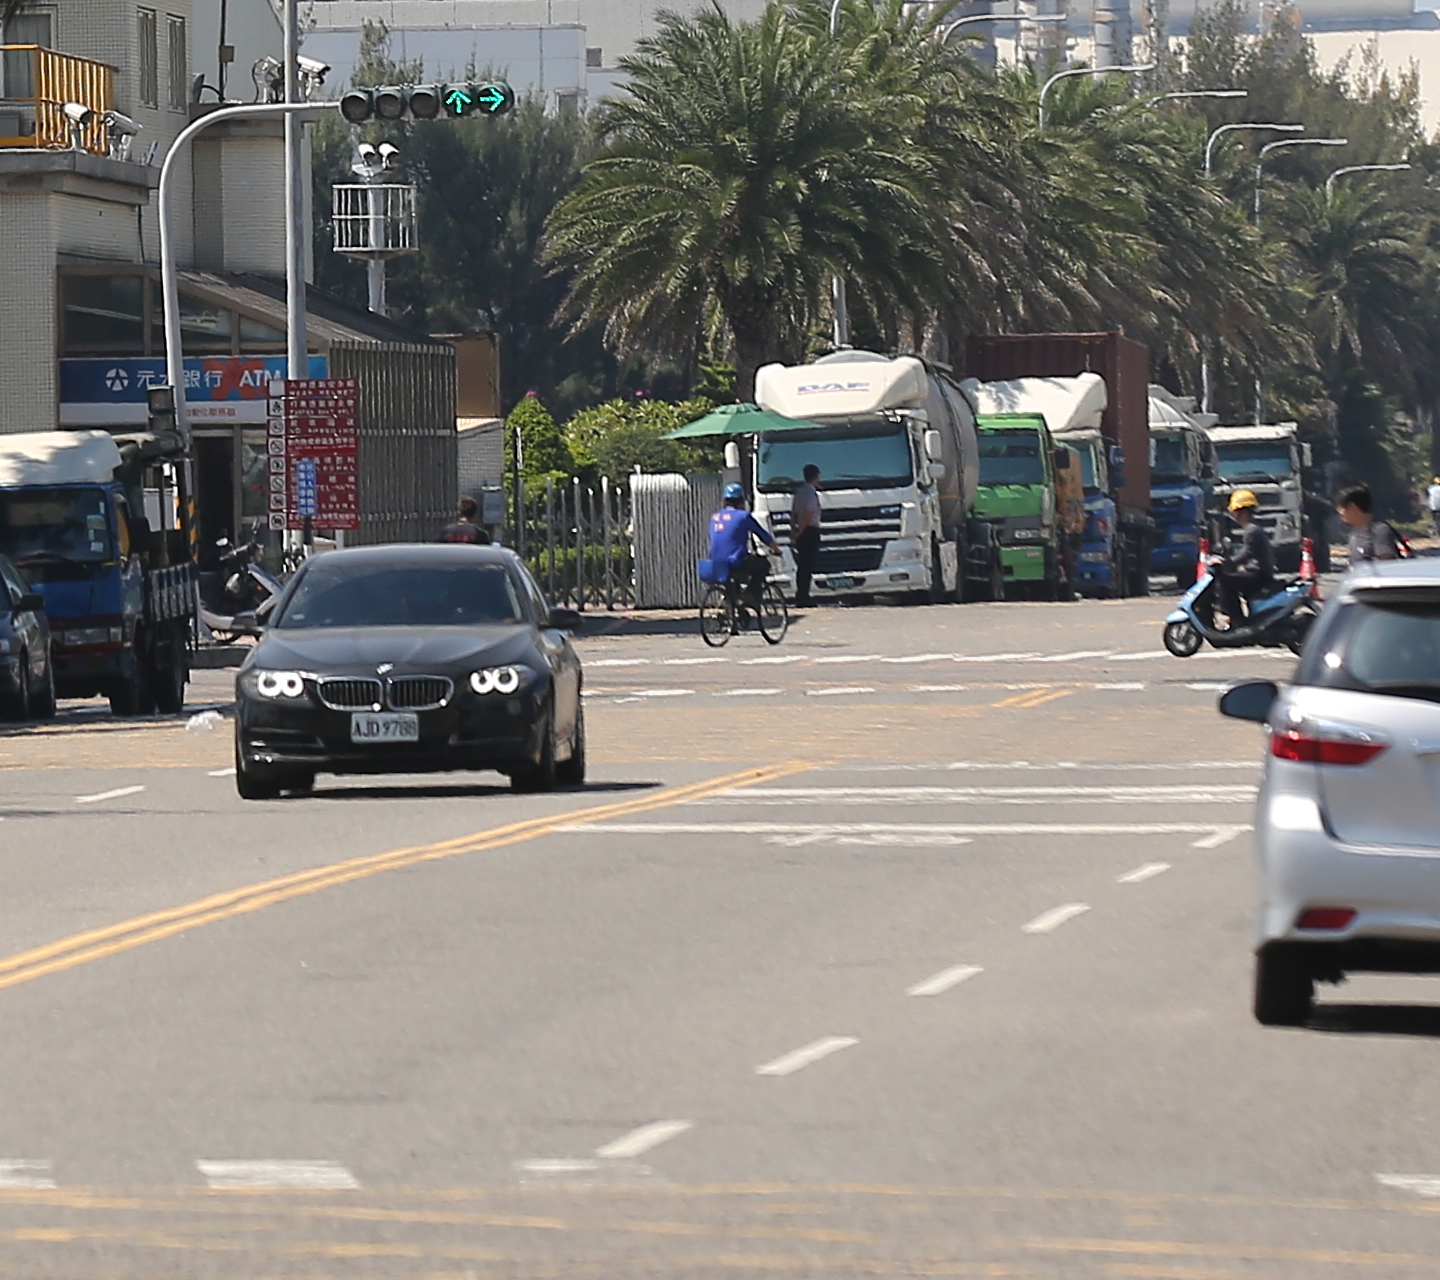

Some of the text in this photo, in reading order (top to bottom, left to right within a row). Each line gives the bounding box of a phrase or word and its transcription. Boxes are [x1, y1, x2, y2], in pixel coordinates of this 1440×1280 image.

[137, 369, 282, 389] 元銀行 ATM
